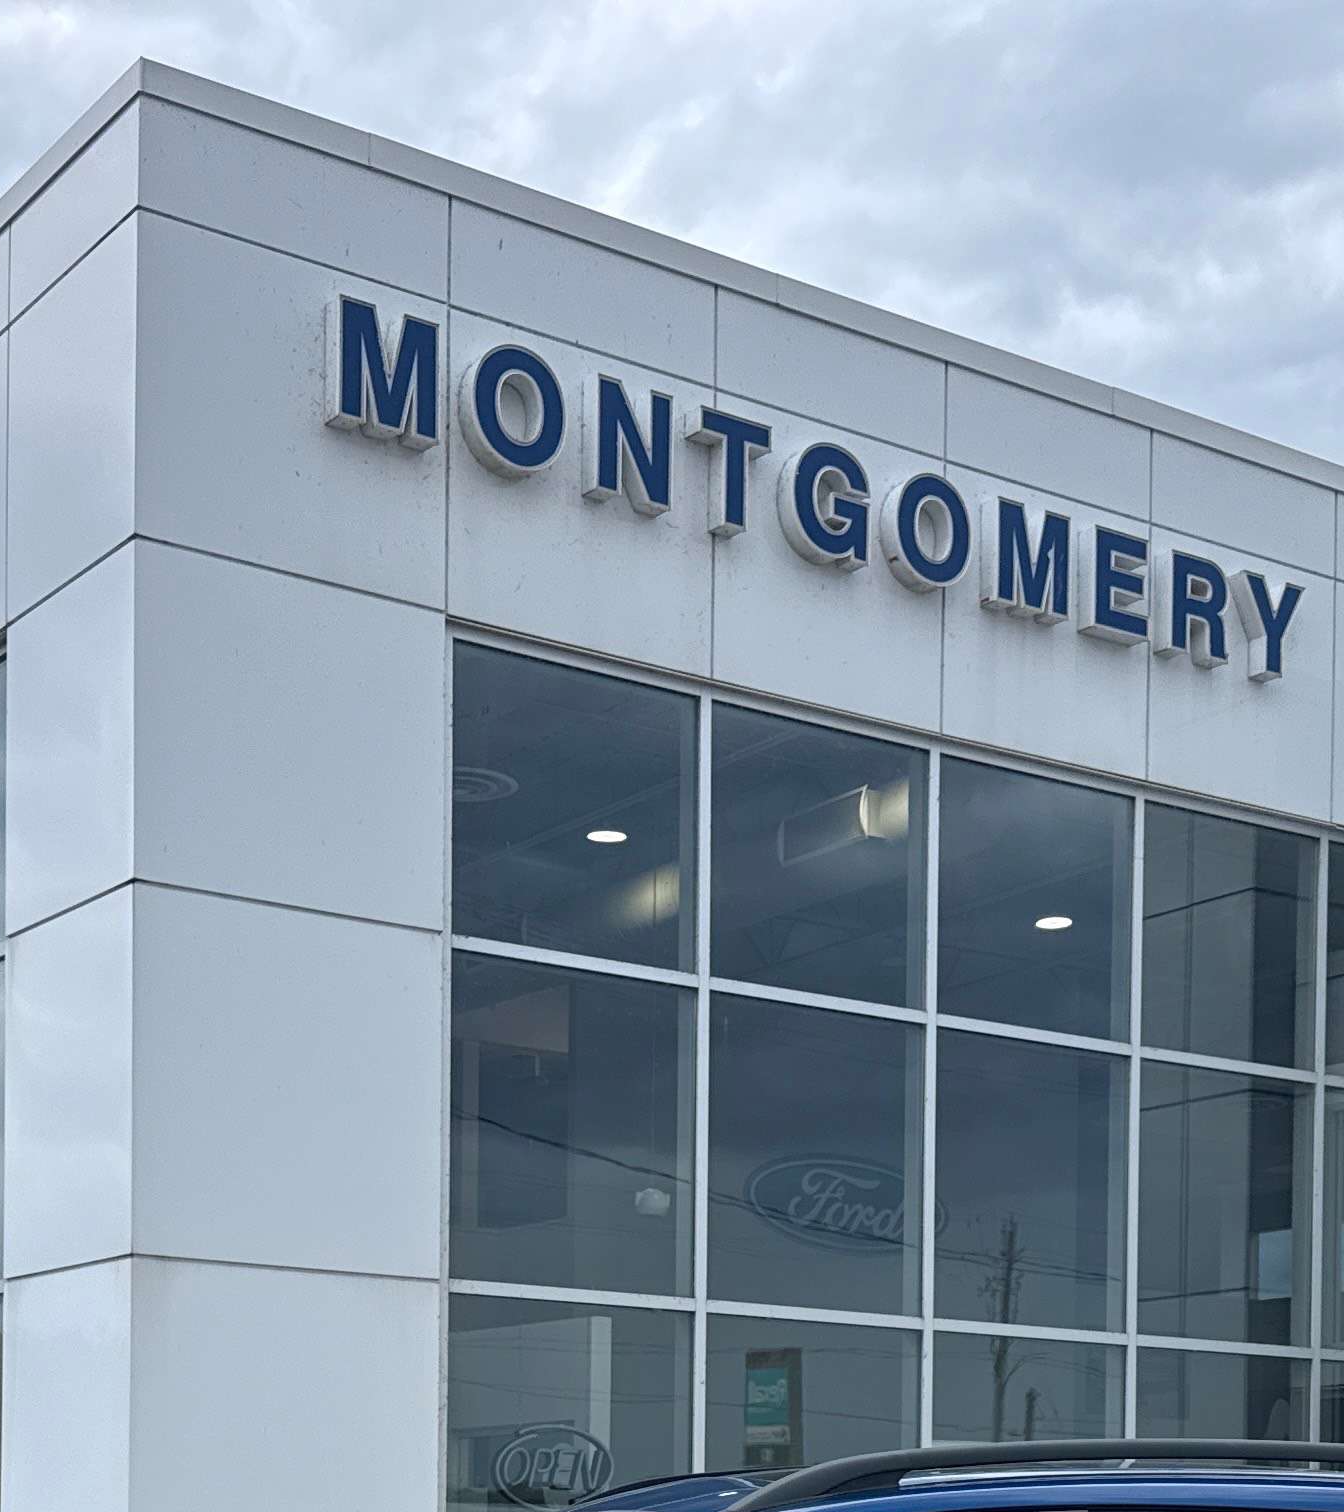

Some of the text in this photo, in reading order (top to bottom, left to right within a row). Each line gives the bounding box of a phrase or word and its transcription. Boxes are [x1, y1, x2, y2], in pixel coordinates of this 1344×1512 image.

[328, 295, 1306, 682] MONTGOMERY
[788, 1168, 905, 1238] Ford
[504, 1447, 605, 1492] OPEN
